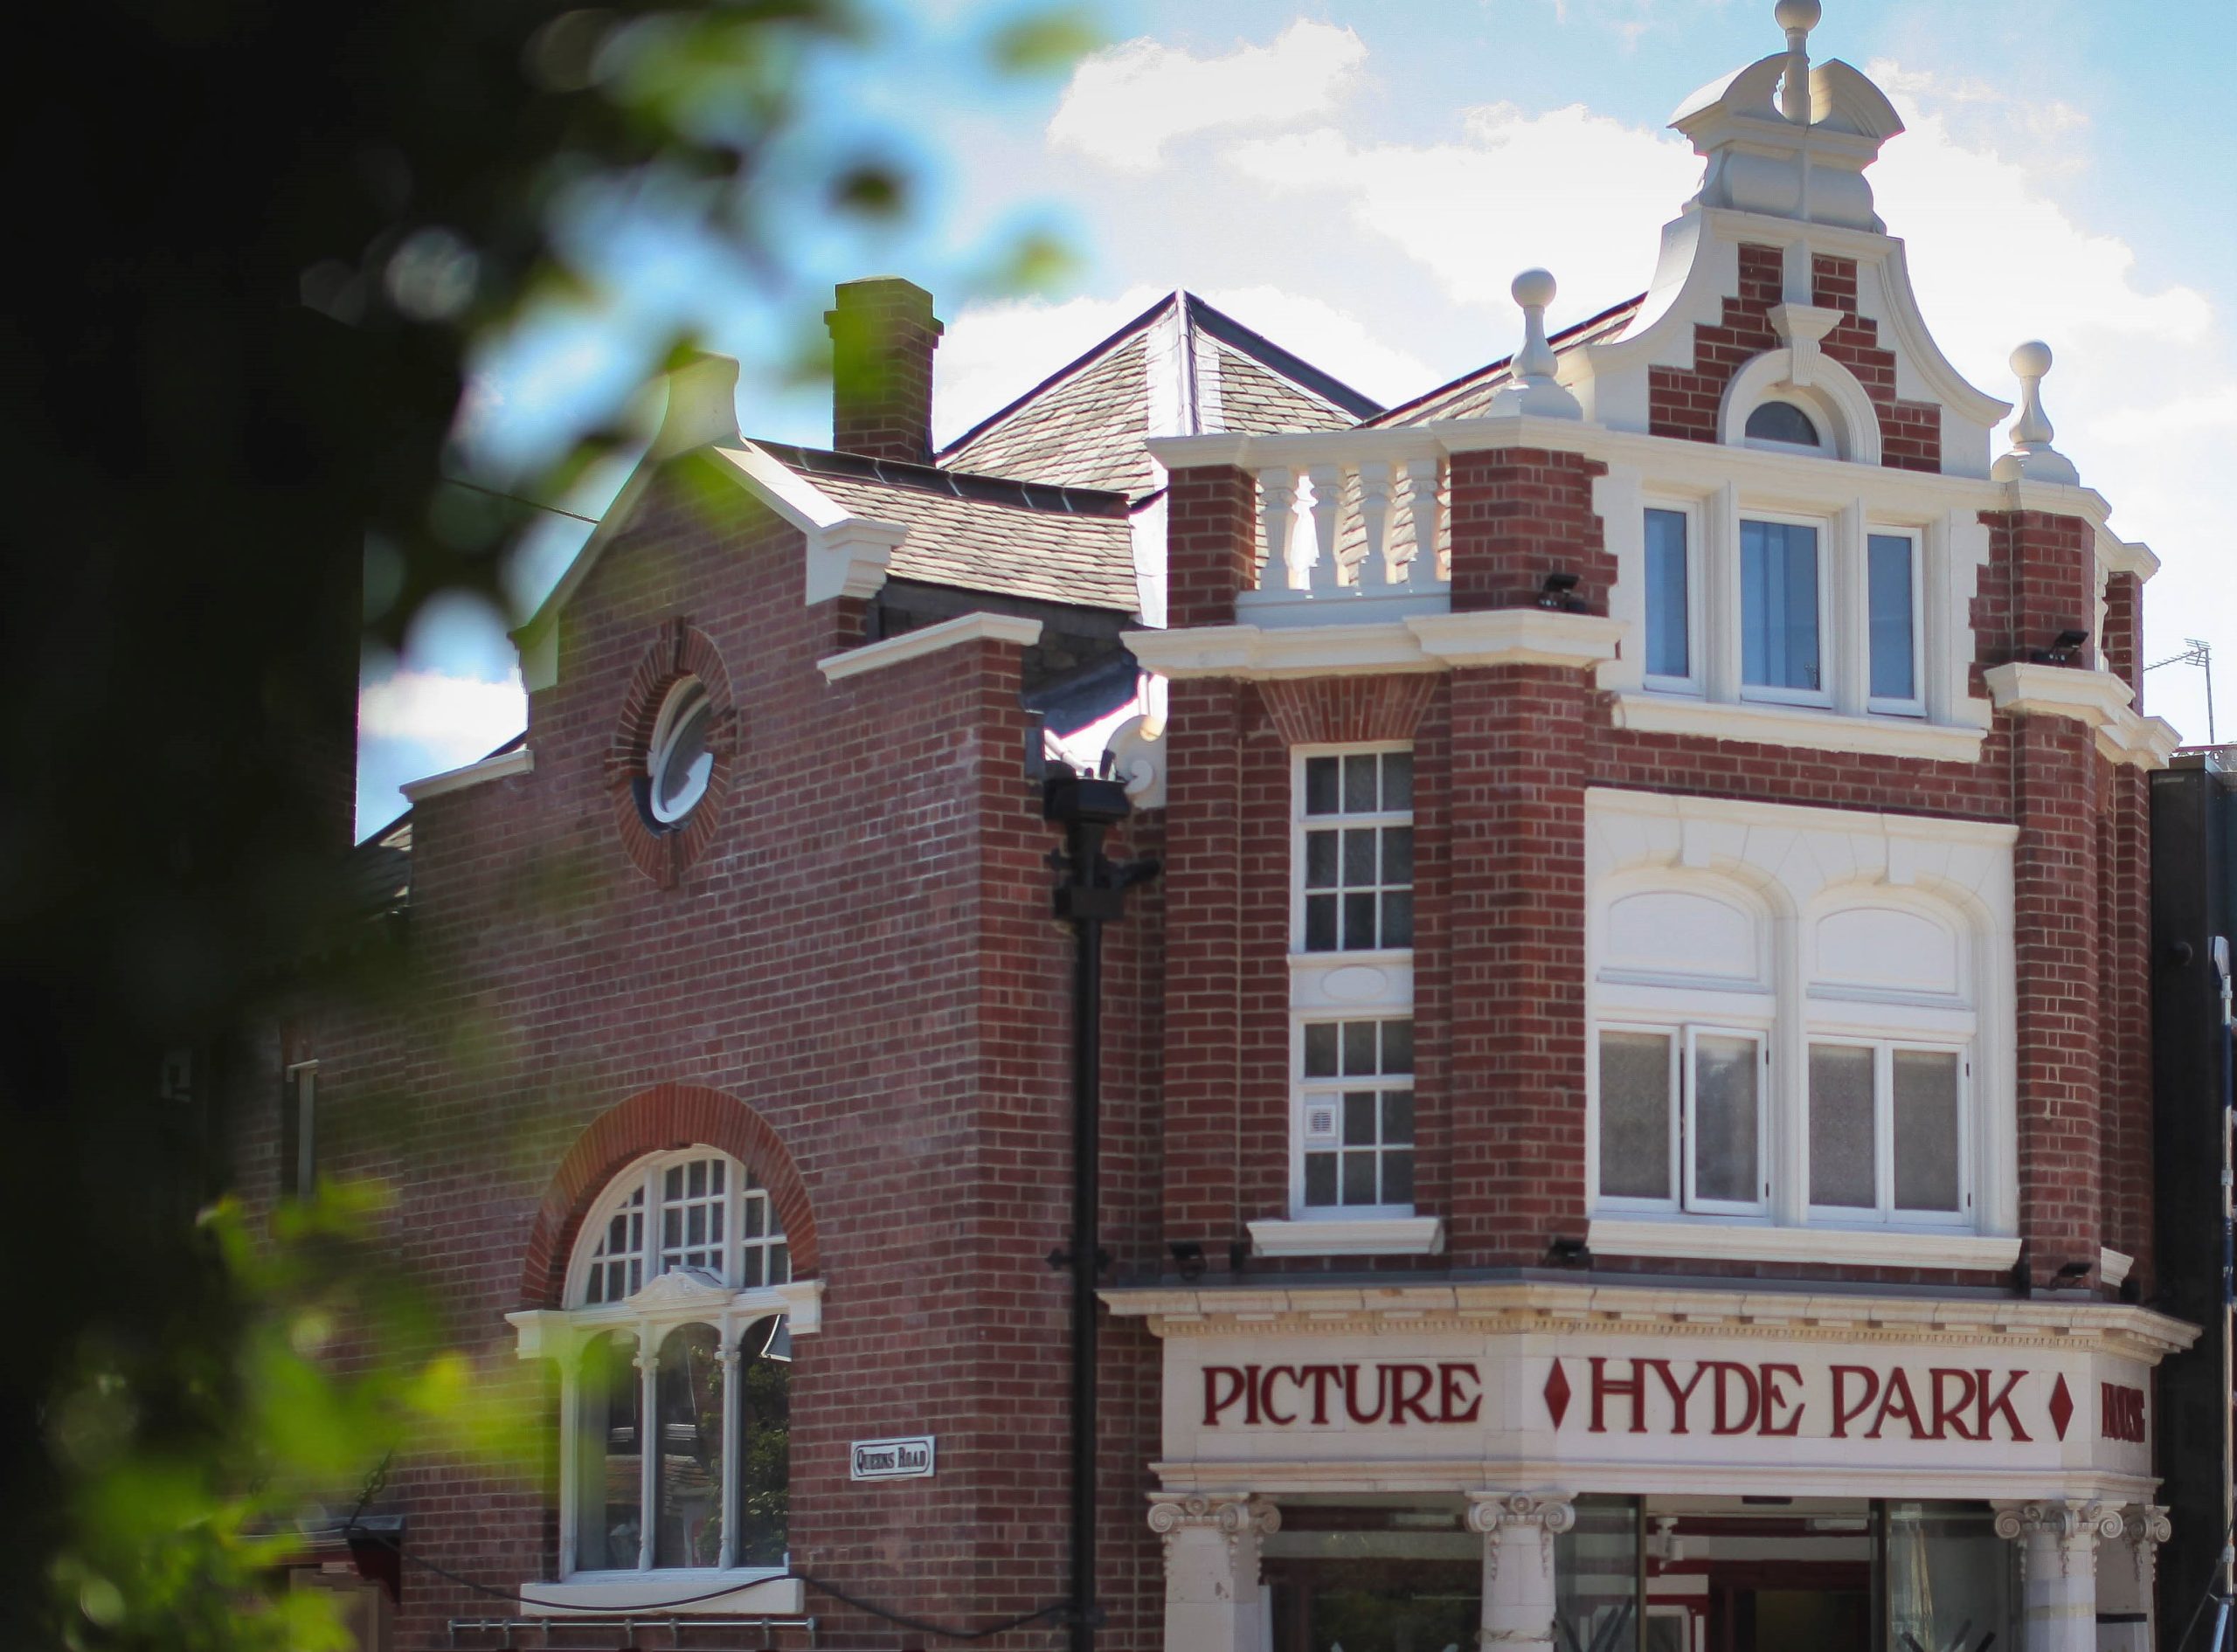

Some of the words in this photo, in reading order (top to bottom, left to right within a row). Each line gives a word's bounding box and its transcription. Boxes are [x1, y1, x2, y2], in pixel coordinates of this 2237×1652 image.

[1201, 1363, 1484, 1427] PICTURE
[1587, 1356, 1806, 1437] HYDE
[1829, 1365, 2033, 1442] PARK
